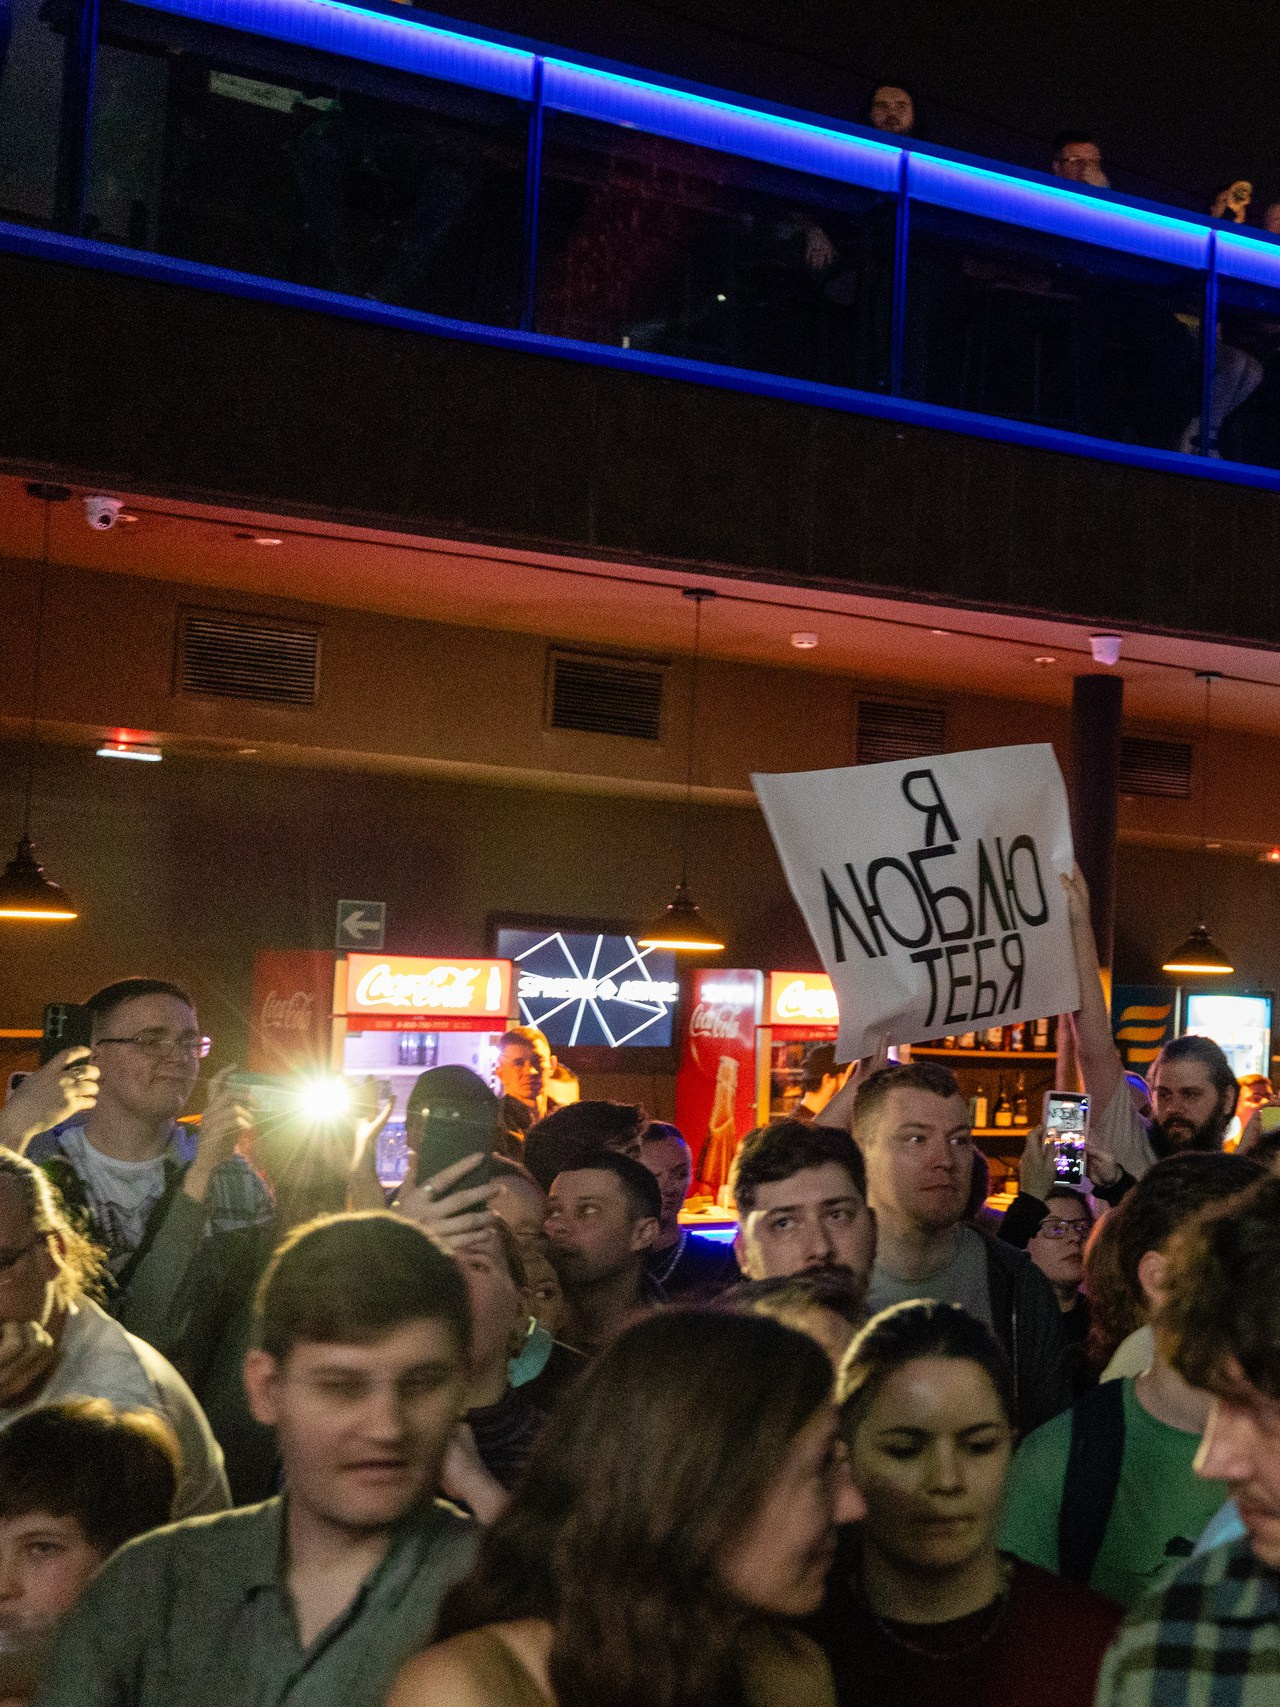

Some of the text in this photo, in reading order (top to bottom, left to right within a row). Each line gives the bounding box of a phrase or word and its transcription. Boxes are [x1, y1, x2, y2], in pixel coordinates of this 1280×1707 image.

[901, 769, 960, 847] Я
[820, 834, 1048, 963] ЛЮБЛЮ
[910, 933, 1024, 1028] ТЕБЯ
